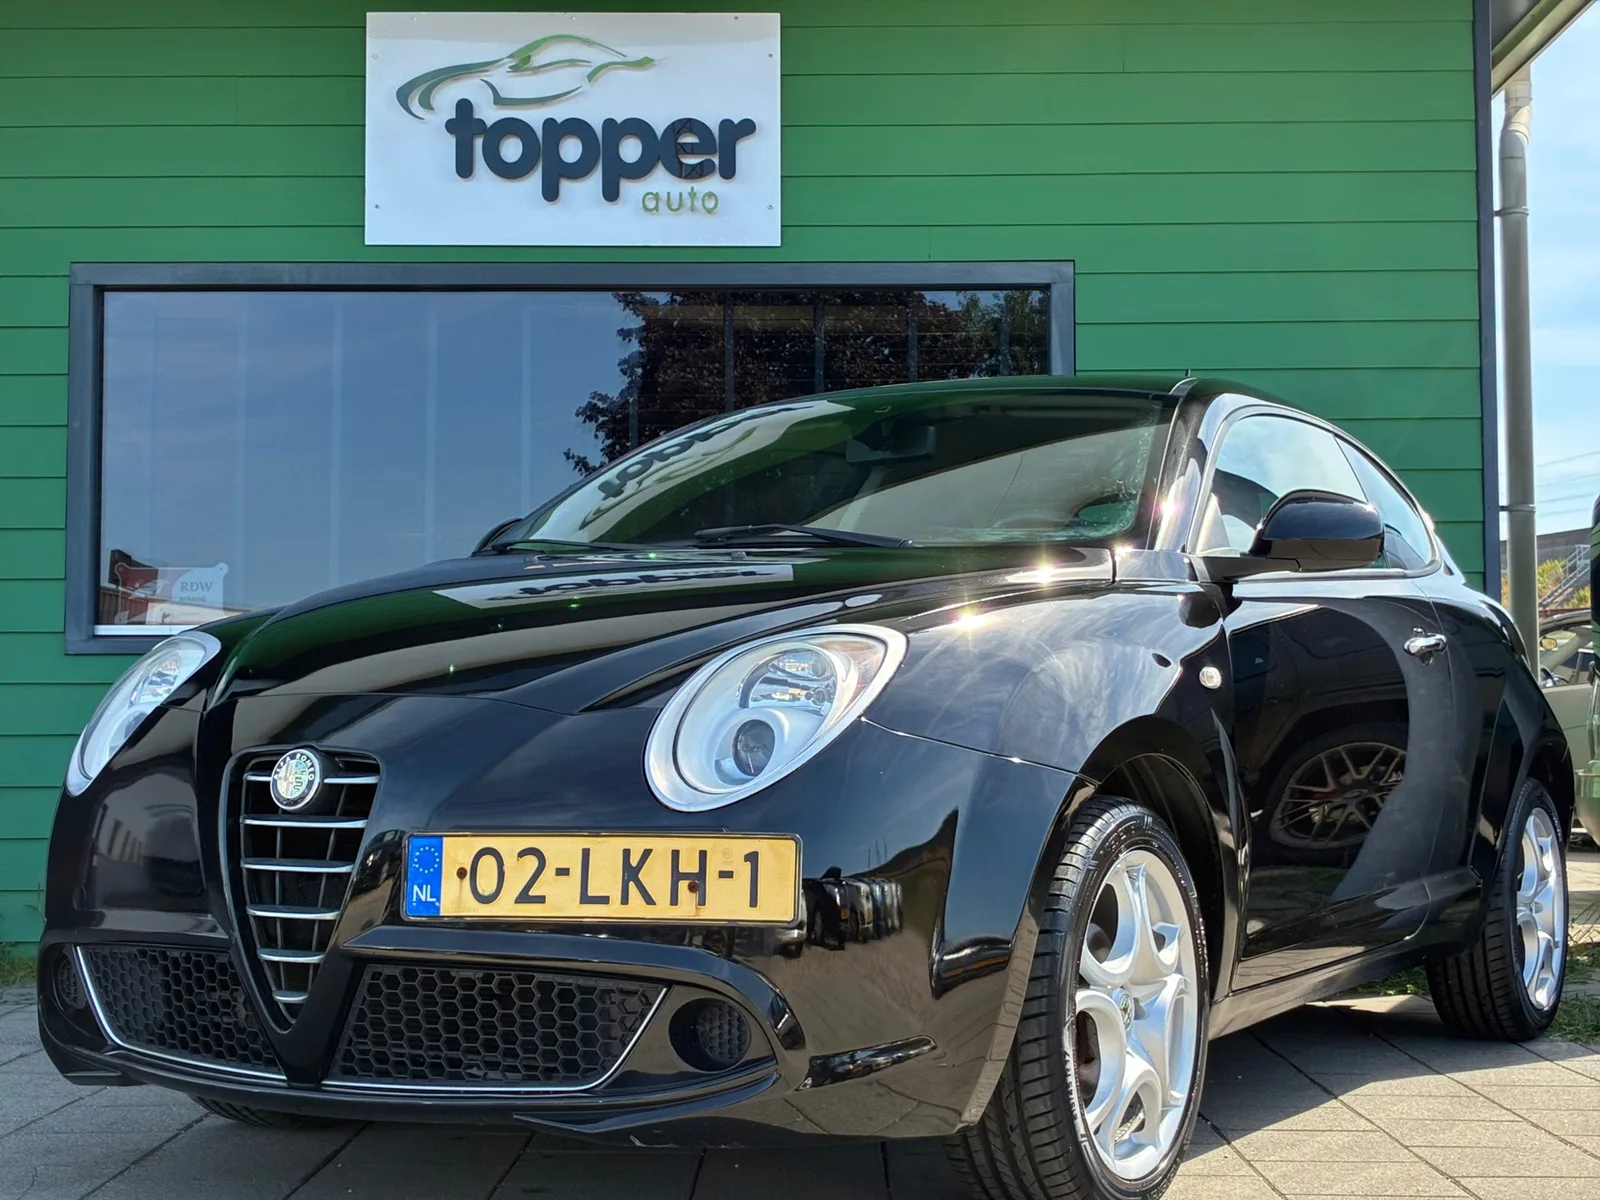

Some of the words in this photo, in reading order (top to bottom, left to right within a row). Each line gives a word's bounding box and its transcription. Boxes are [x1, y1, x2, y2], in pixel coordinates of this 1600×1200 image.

[444, 98, 756, 202] topper
[641, 186, 719, 213] auto
[180, 581, 213, 592] RDW
[295, 753, 315, 781] ROMEO
[469, 846, 760, 908] 02-LKH-1
[412, 884, 437, 902] NL
